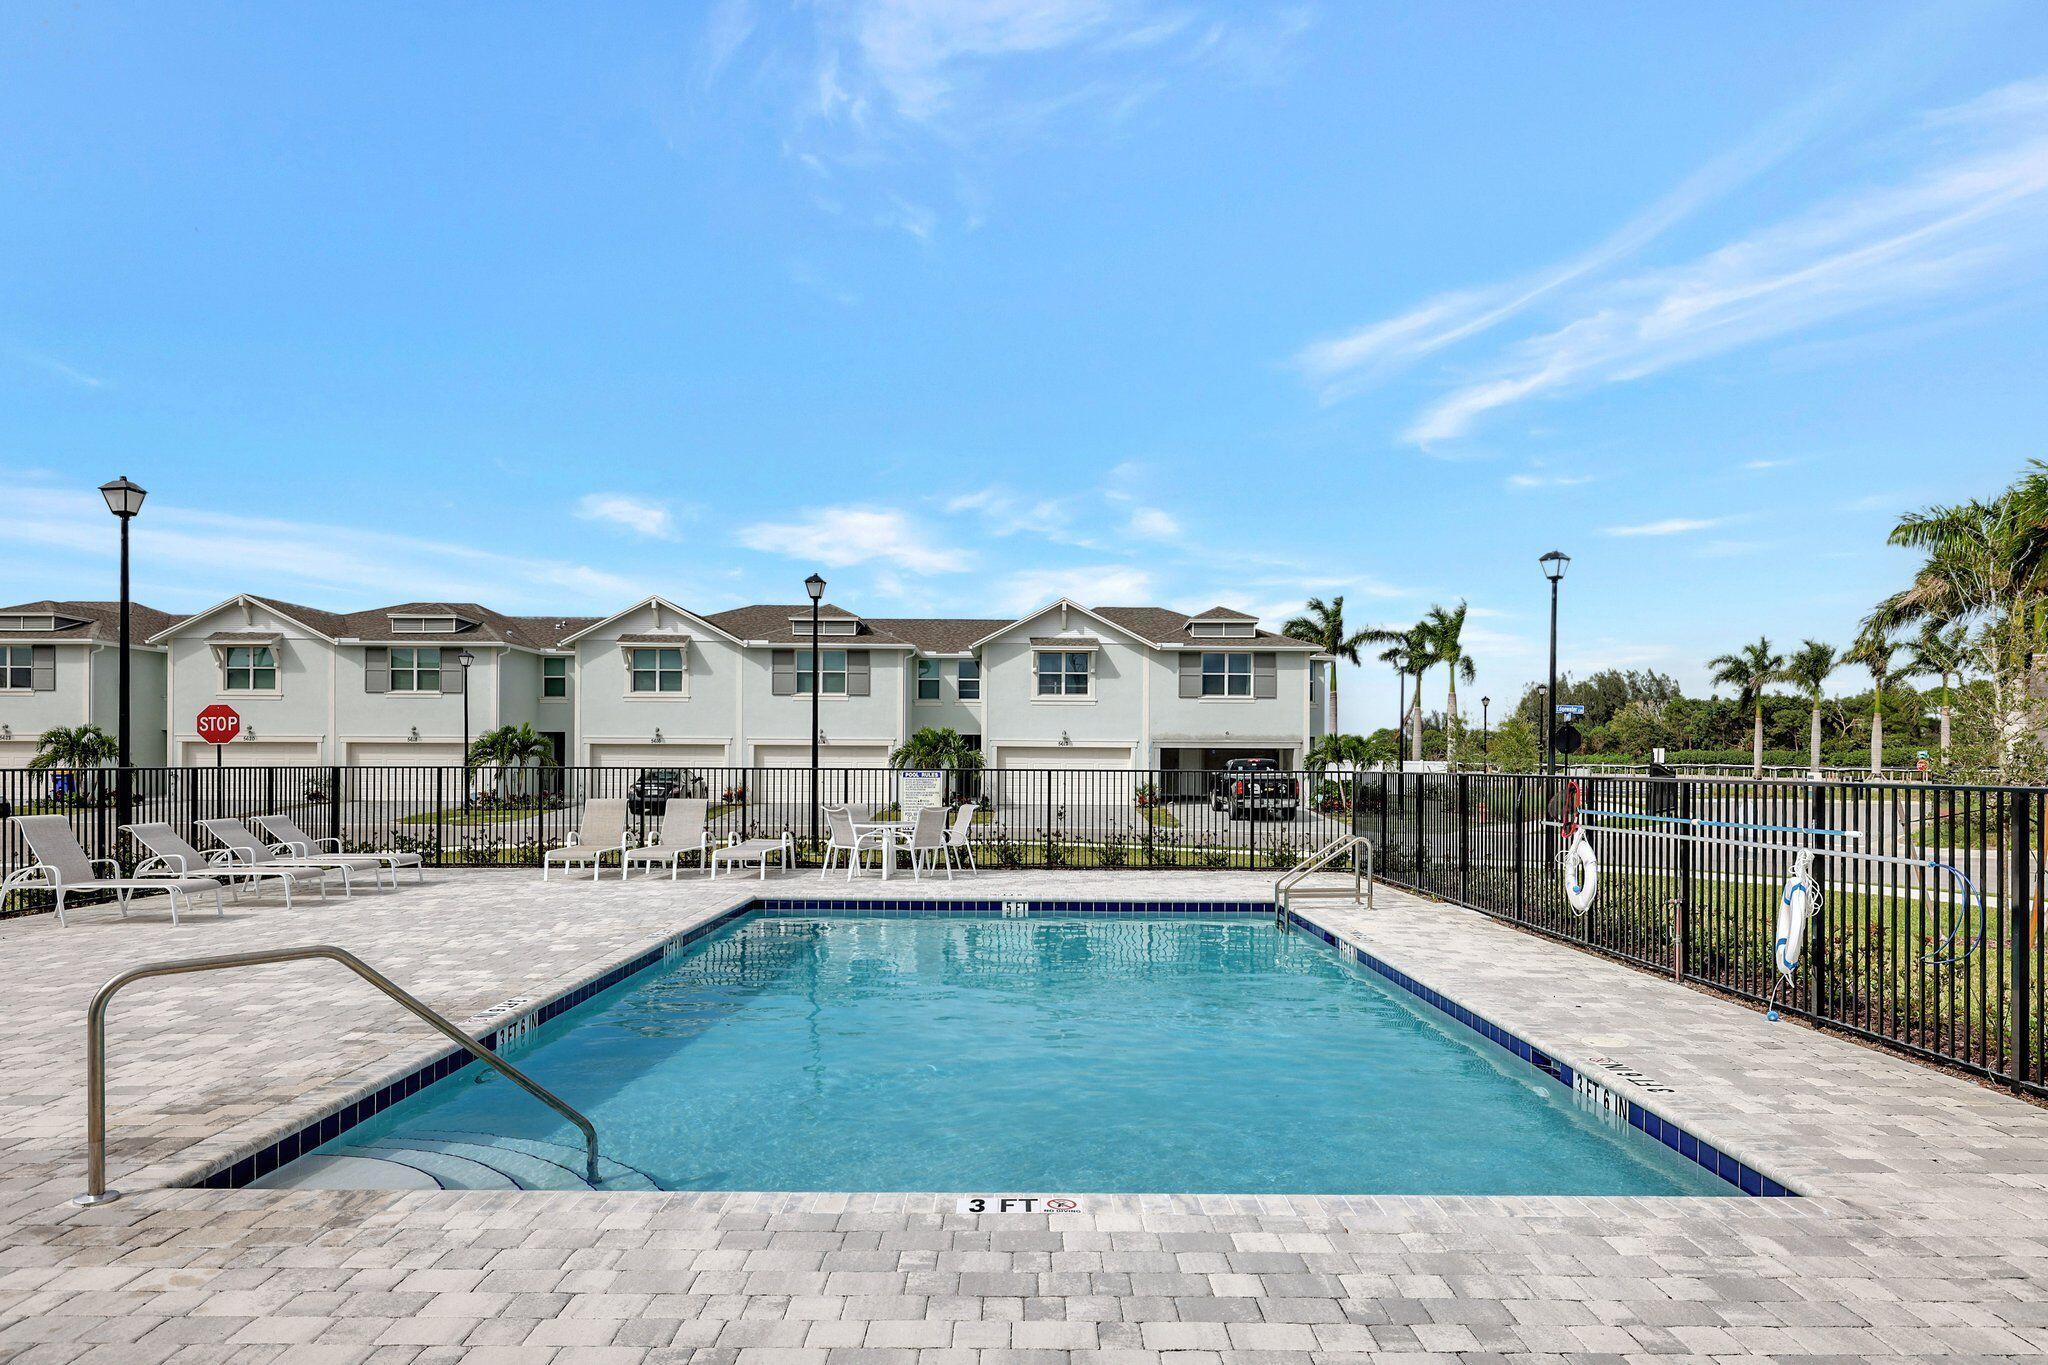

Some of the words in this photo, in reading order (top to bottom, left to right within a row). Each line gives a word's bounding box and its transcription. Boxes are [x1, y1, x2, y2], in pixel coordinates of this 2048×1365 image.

[199, 716, 238, 732] STOP
[1006, 901, 1012, 915] 5
[1015, 901, 1028, 915] FT
[500, 1029, 505, 1046] 3
[507, 1022, 518, 1042] FT
[520, 1018, 526, 1035] 6
[529, 1010, 538, 1030] IN
[1577, 1073, 1583, 1094] 3
[1586, 1078, 1600, 1103] FT
[1603, 1088, 1610, 1110] 6
[1614, 1094, 1627, 1121] IN
[968, 1198, 986, 1213] 3
[1000, 1198, 1038, 1213] FT
